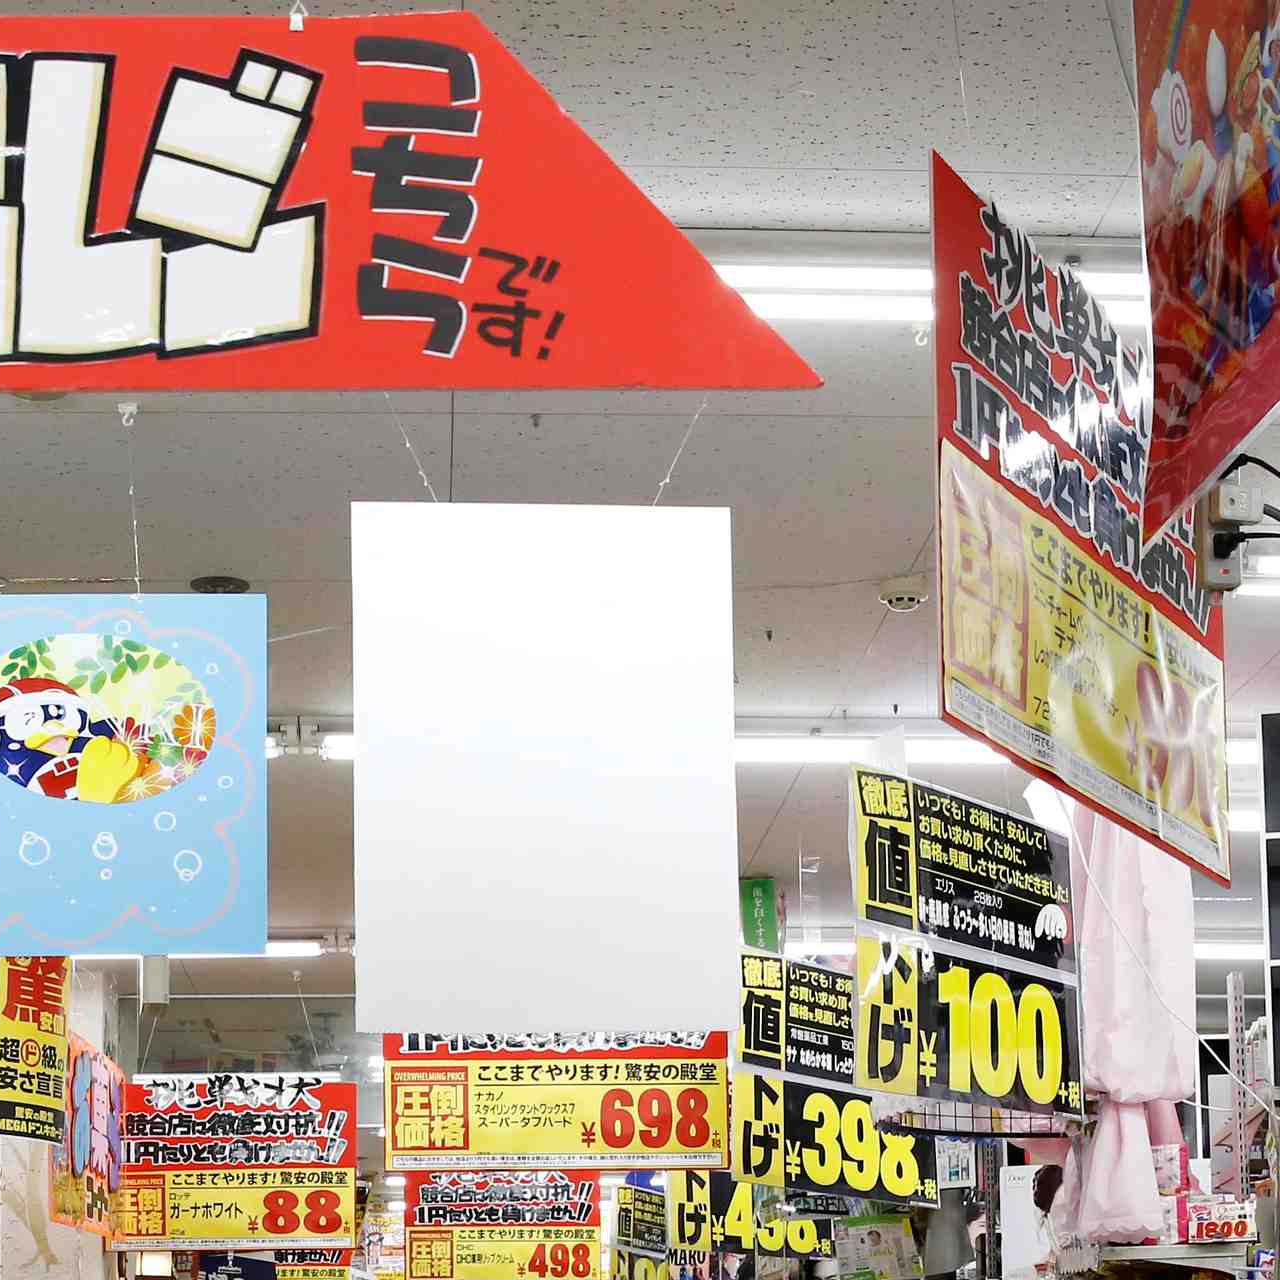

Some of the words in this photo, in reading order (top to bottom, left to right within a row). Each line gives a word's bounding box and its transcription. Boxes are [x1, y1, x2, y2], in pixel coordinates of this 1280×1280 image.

[350, 35, 483, 359] こちら
[861, 775, 910, 819] 徹底
[393, 1072, 445, 1082] OVERWHELMING
[447, 1072, 465, 1082] PRICE
[474, 1090, 504, 1102] ナカノ
